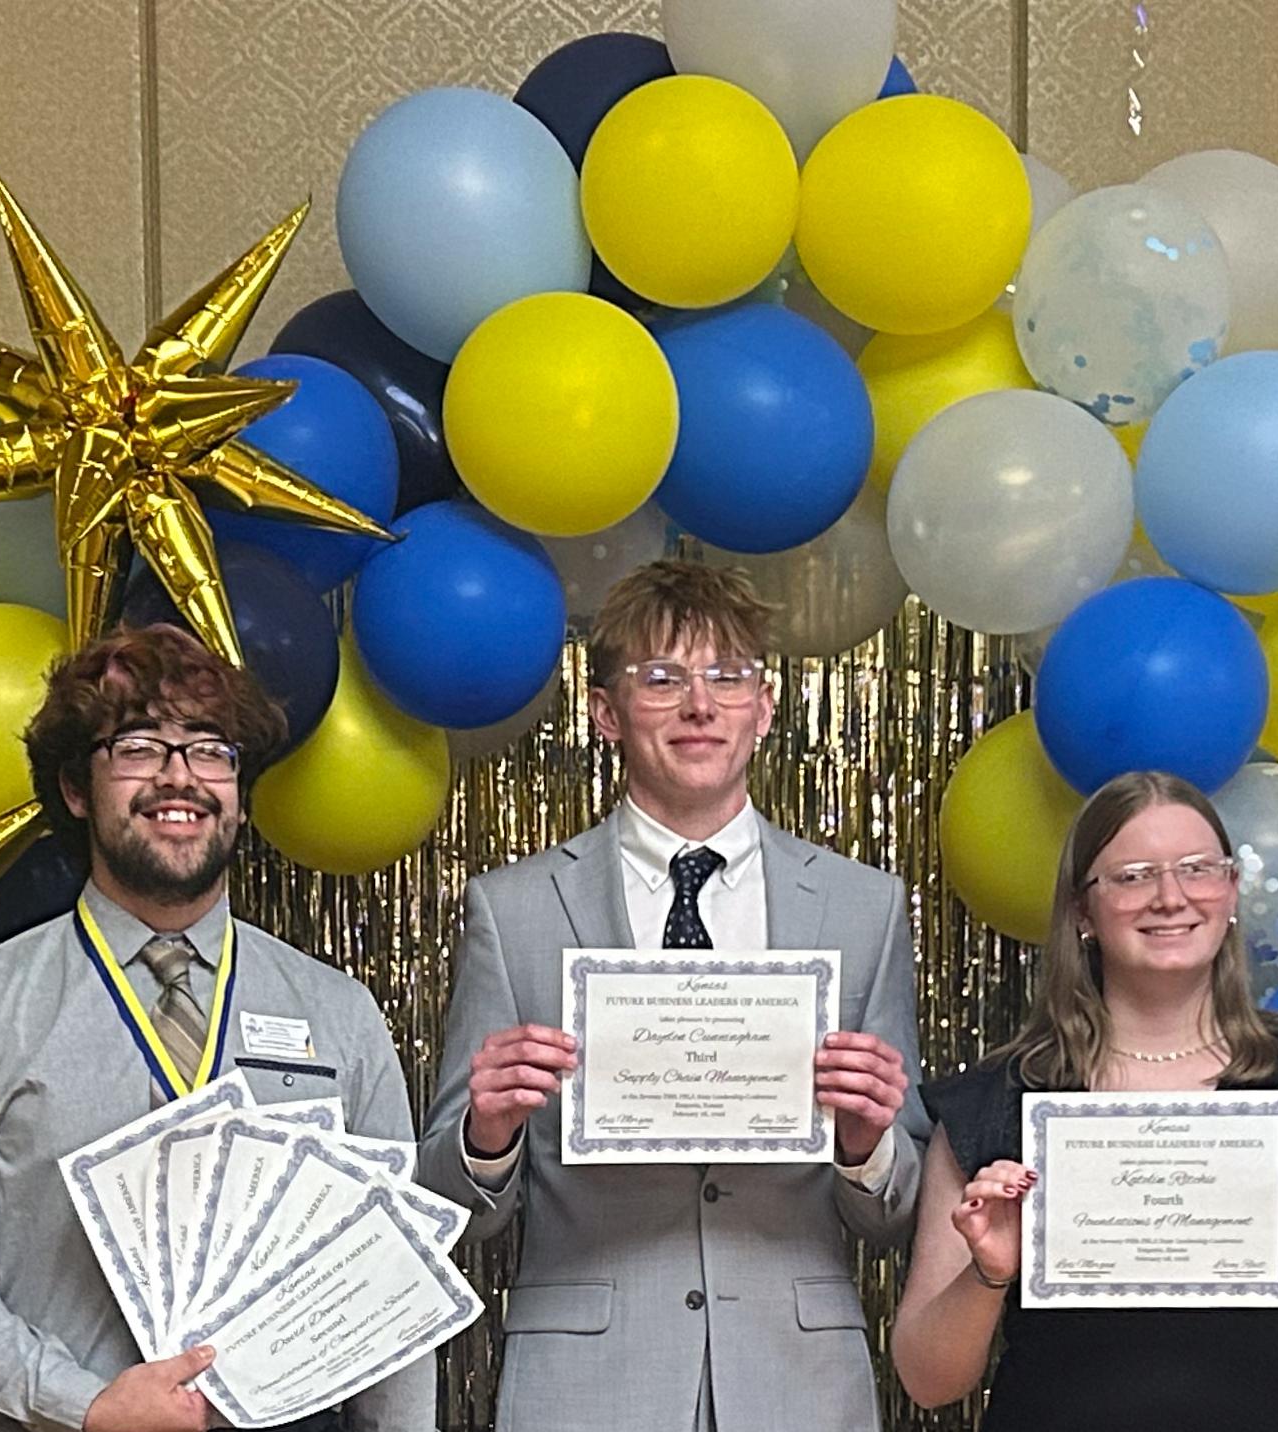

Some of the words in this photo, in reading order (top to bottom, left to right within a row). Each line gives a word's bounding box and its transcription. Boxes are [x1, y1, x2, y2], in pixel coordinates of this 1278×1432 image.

[678, 976, 727, 991] Kansas
[606, 997, 644, 1006] FUTURE
[647, 997, 693, 1006] BUSINESS
[695, 997, 738, 1006] LEADERS
[740, 997, 753, 1006] OF
[755, 997, 799, 1006] AMERICA
[685, 1051, 717, 1062] Third
[705, 1069, 788, 1085] Management
[1138, 1118, 1190, 1134] Kansas
[1065, 1140, 1105, 1149] FUTURE
[1107, 1140, 1154, 1149] BUSINESS
[1156, 1140, 1201, 1149] LEADERS
[1203, 1140, 1216, 1148] OF
[1219, 1140, 1264, 1148] AMERICA
[192, 1152, 202, 1195] MERICA
[247, 1156, 265, 1199] AMERICA
[116, 1173, 137, 1214] AMERICA
[1143, 1194, 1183, 1206] Fourth
[295, 1221, 306, 1234] OF
[304, 1183, 333, 1222] AMERICA
[1073, 1212, 1151, 1228] Foundations
[1153, 1215, 1167, 1229] of
[1169, 1213, 1253, 1229] Management
[224, 1327, 258, 1354] FUTURE
[257, 1298, 297, 1330] BUSINESS
[295, 1270, 333, 1300] LEADERS
[332, 1261, 344, 1273] OF
[345, 1233, 382, 1264] AMERICA
[309, 1314, 347, 1344] Second
